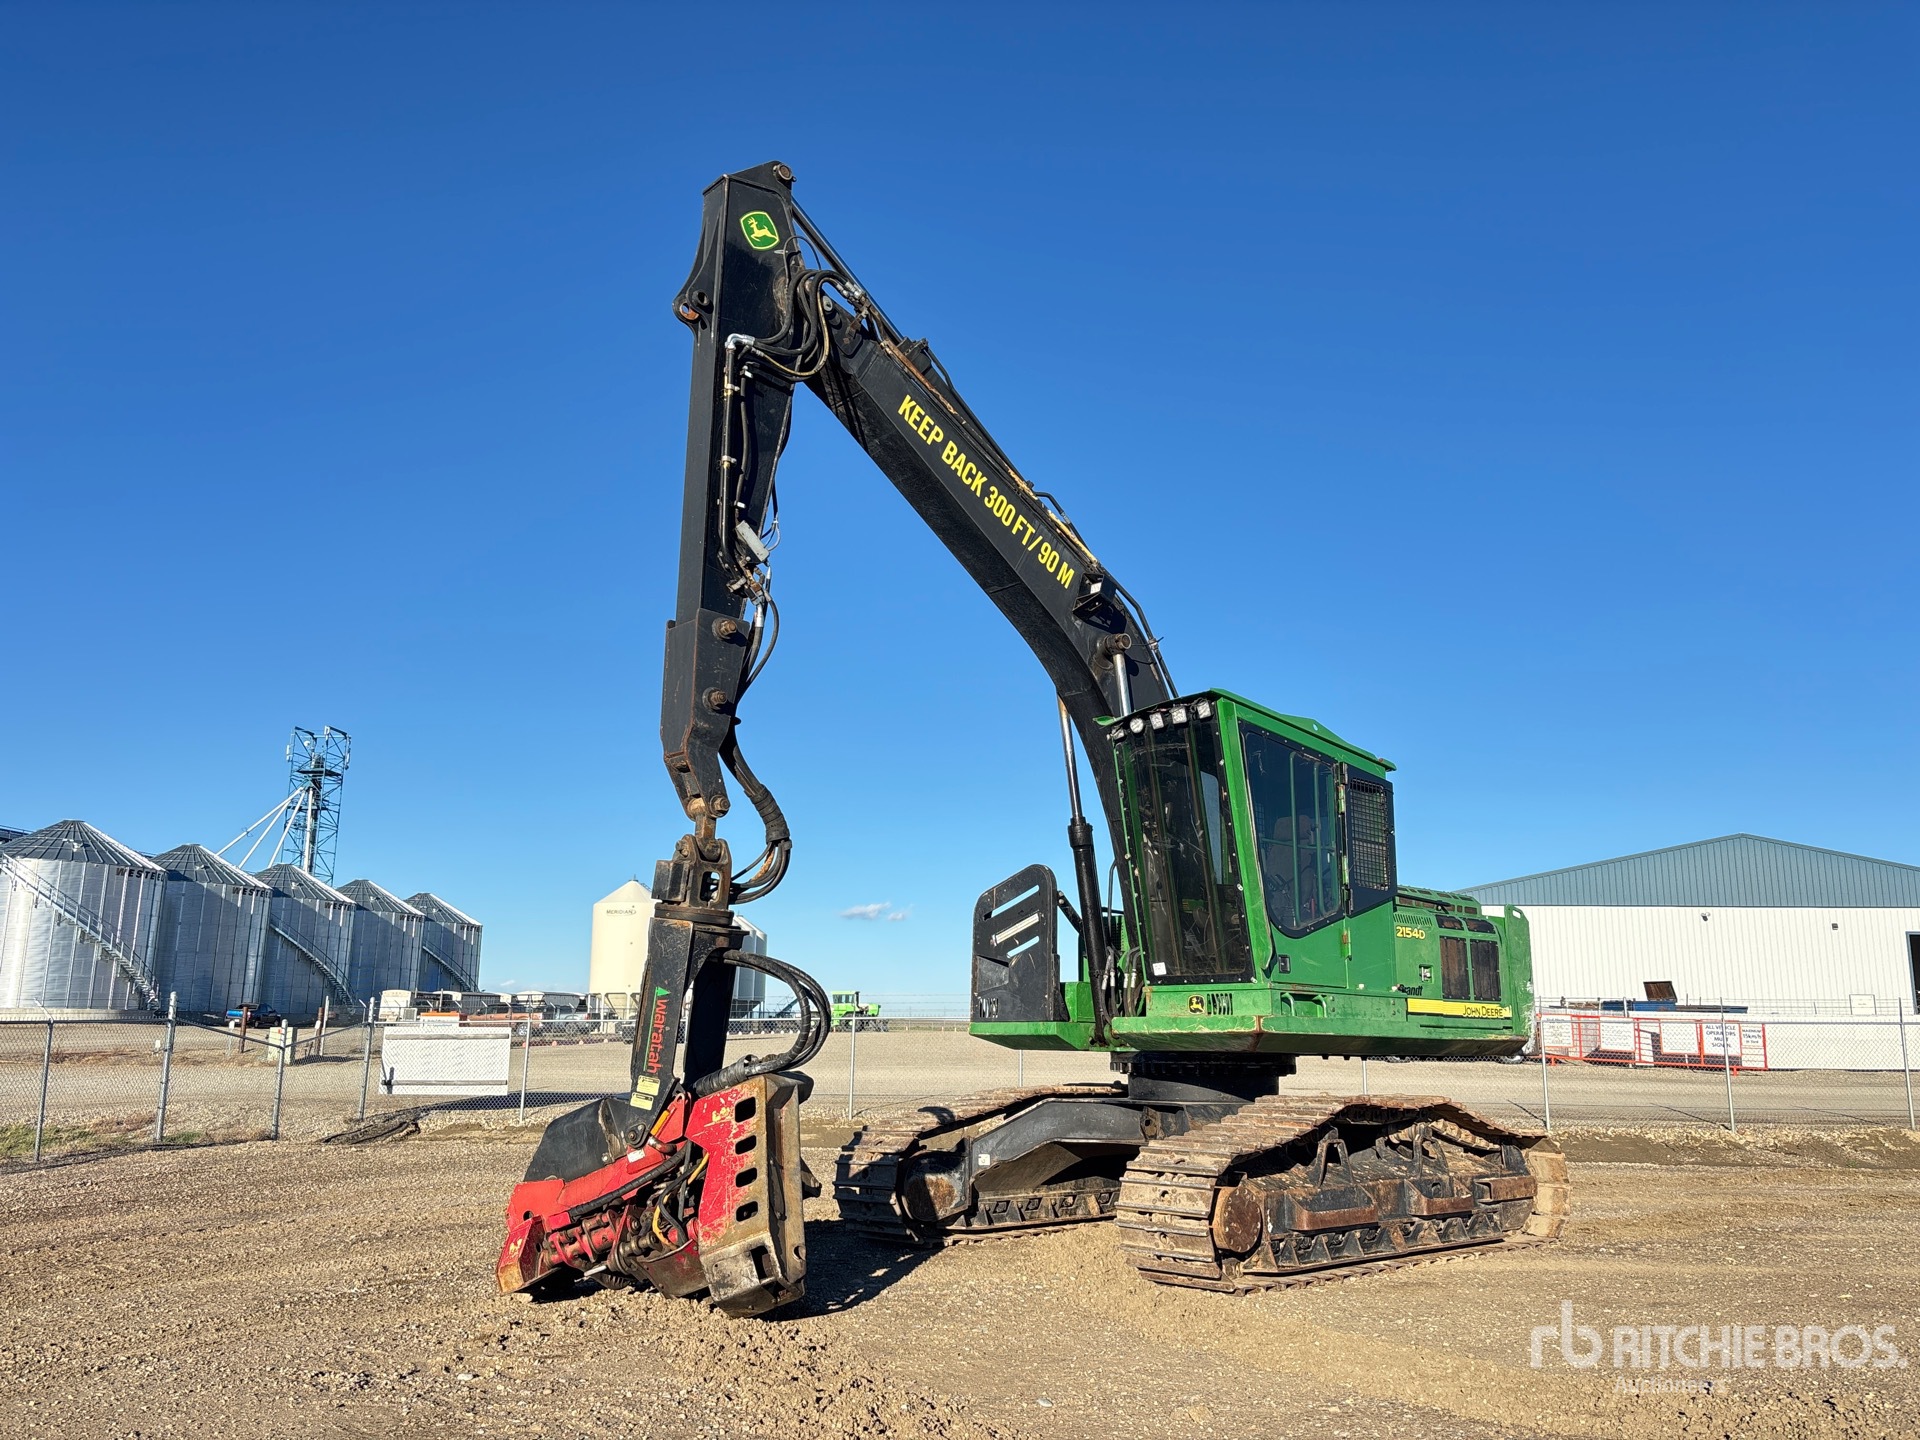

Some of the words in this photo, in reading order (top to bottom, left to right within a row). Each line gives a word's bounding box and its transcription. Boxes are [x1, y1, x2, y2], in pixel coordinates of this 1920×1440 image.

[897, 394, 944, 446] KEEP
[941, 440, 988, 498] BACK
[1056, 562, 1075, 589] M
[1395, 926, 1426, 940] 2154D
[1462, 1004, 1481, 1016] JOHN
[1481, 1005, 1504, 1018] DEERE
